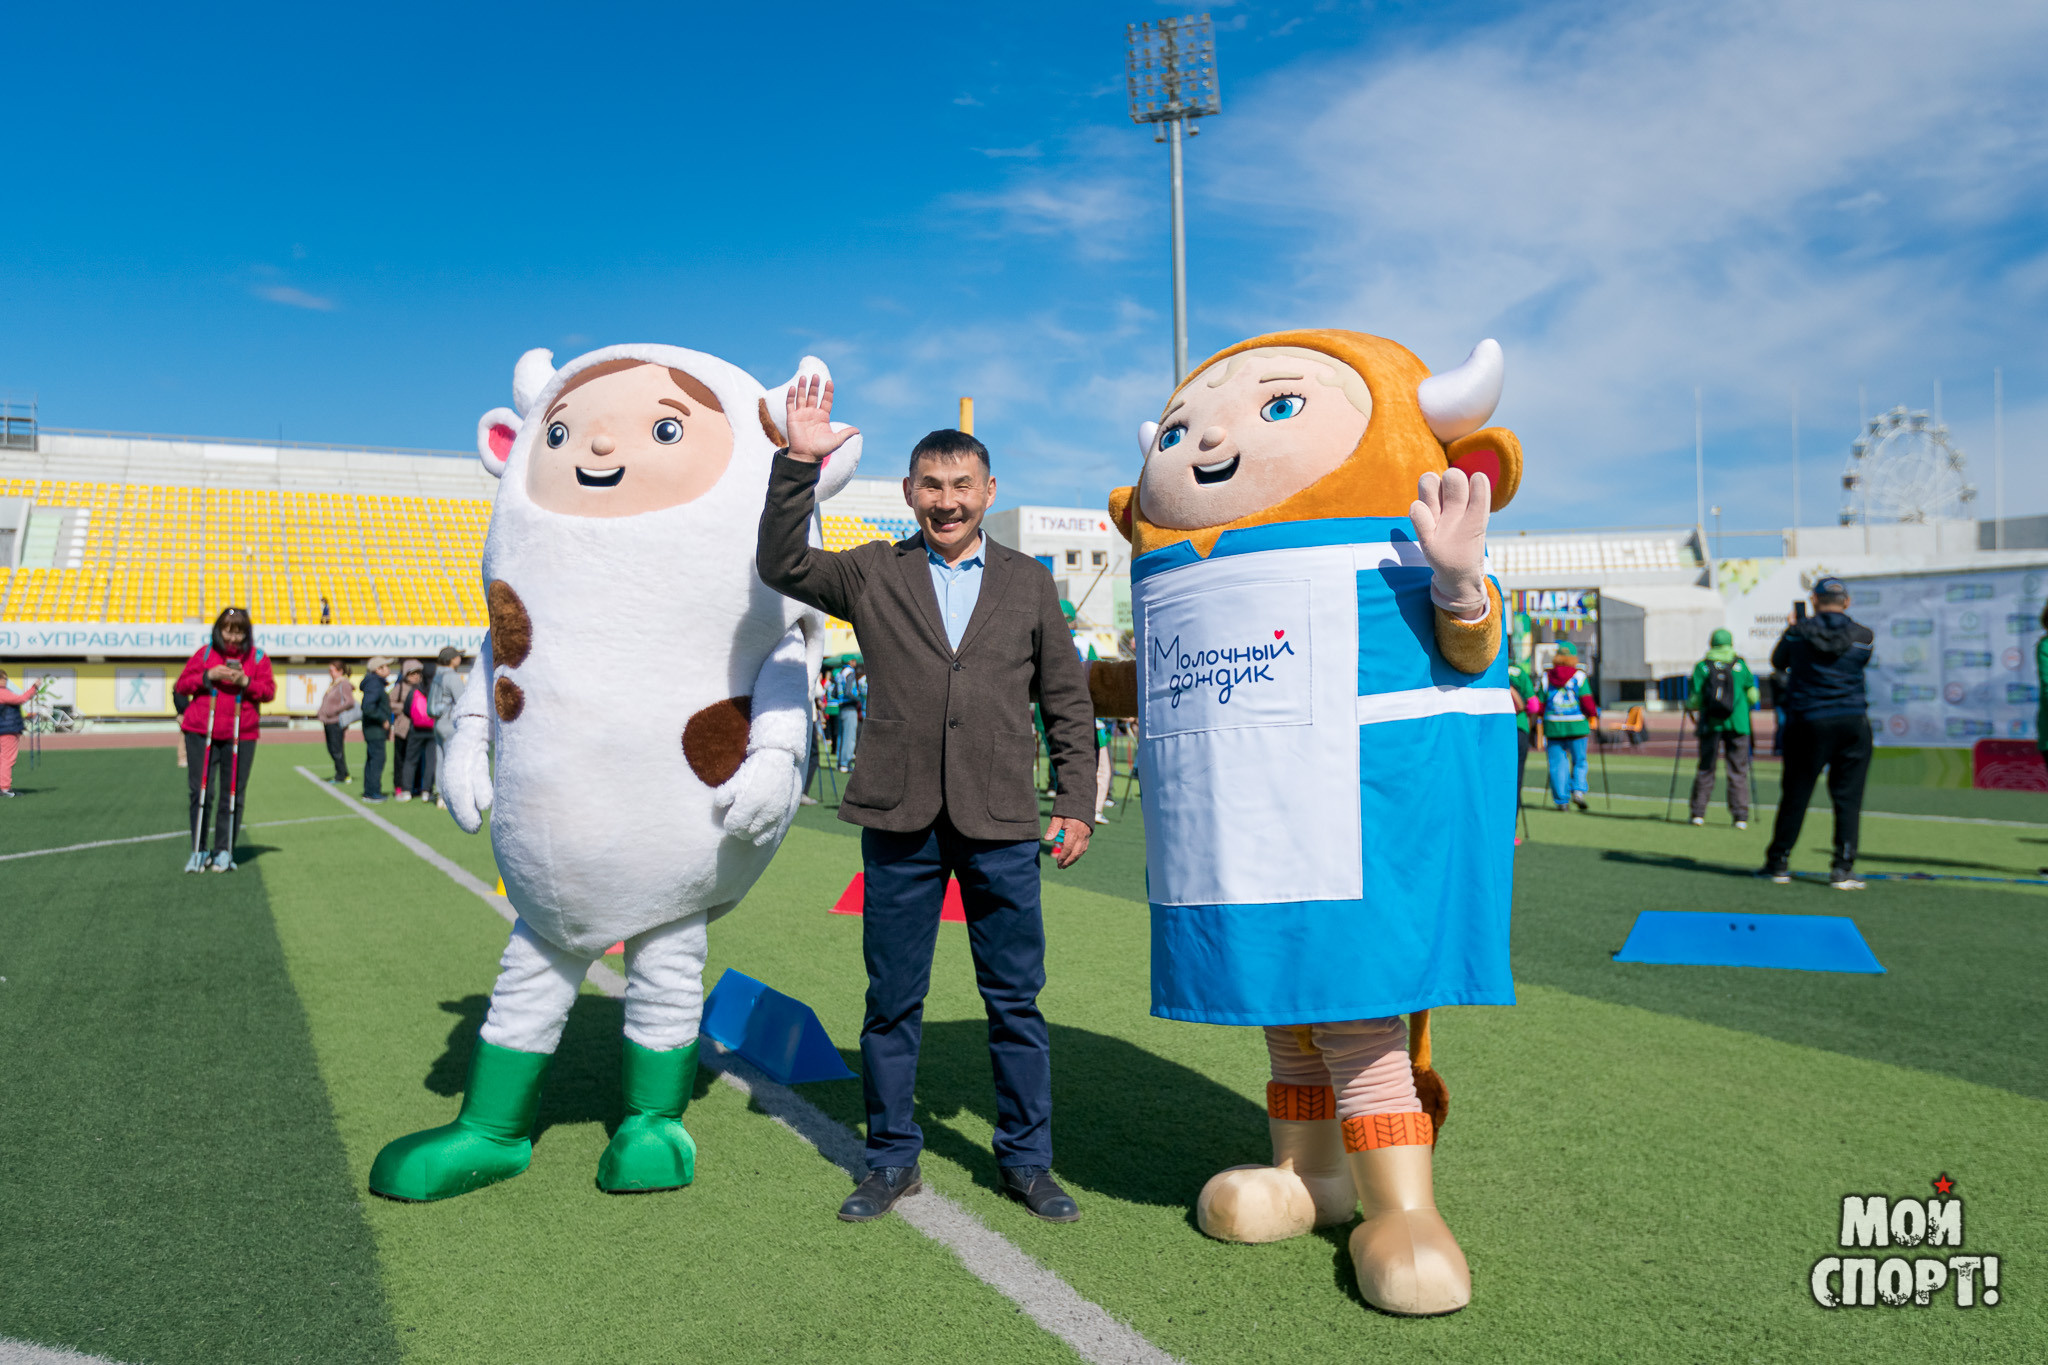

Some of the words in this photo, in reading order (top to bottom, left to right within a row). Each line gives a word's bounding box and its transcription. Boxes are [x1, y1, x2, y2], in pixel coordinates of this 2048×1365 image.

[1040, 516, 1096, 532] ТУАЛЕТ
[1526, 590, 1583, 610] ПАРК
[1754, 614, 1788, 625] МИНИ
[27, 631, 196, 648] «УПРАВЛЕНИЕ
[202, 631, 351, 649] ИЧЕСКОЙ
[356, 632, 463, 649] КУЛЬТУРЫ
[1749, 627, 1785, 638] РОССИ
[1153, 630, 1295, 671] Молочный
[1169, 664, 1275, 708] дождик
